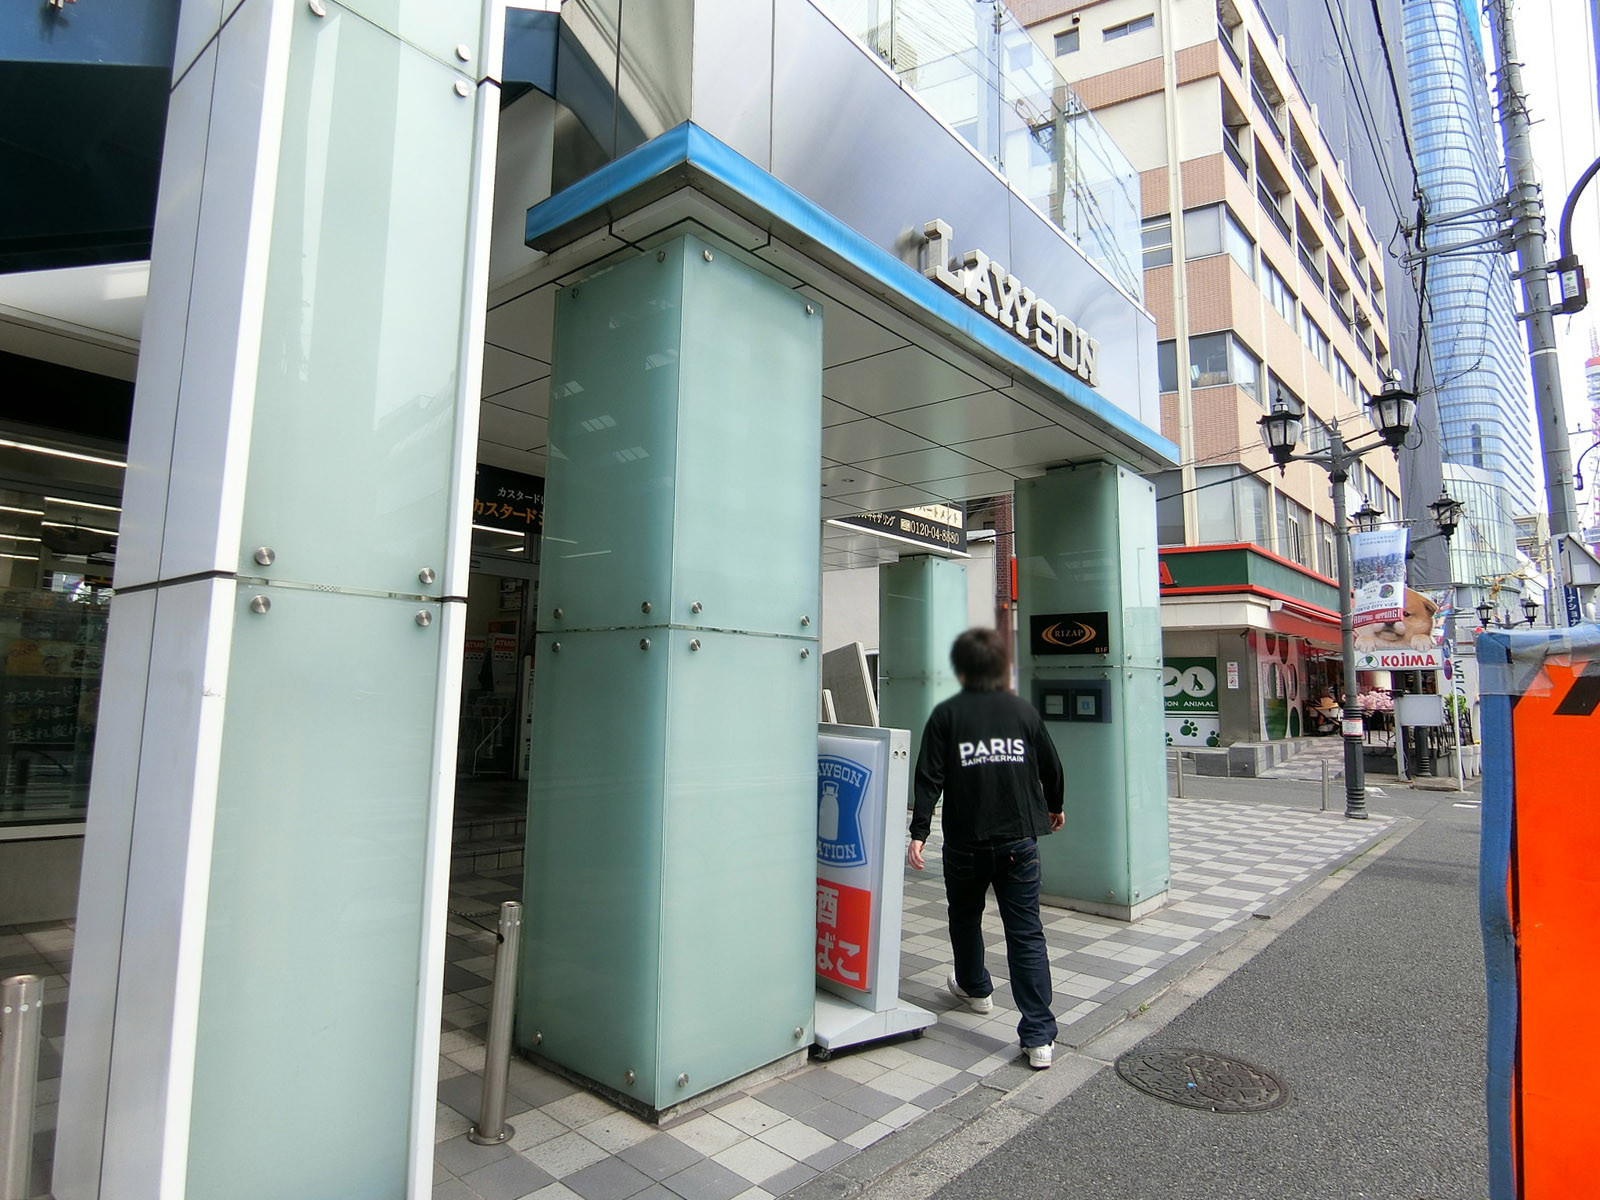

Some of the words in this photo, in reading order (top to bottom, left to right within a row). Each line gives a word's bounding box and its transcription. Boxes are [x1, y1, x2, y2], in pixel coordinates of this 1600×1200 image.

[924, 220, 1100, 387] LAWSON
[1054, 629, 1085, 638] RIZAP
[959, 738, 1025, 759] PARIS
[961, 754, 1024, 767] SAINT-GERMAIN
